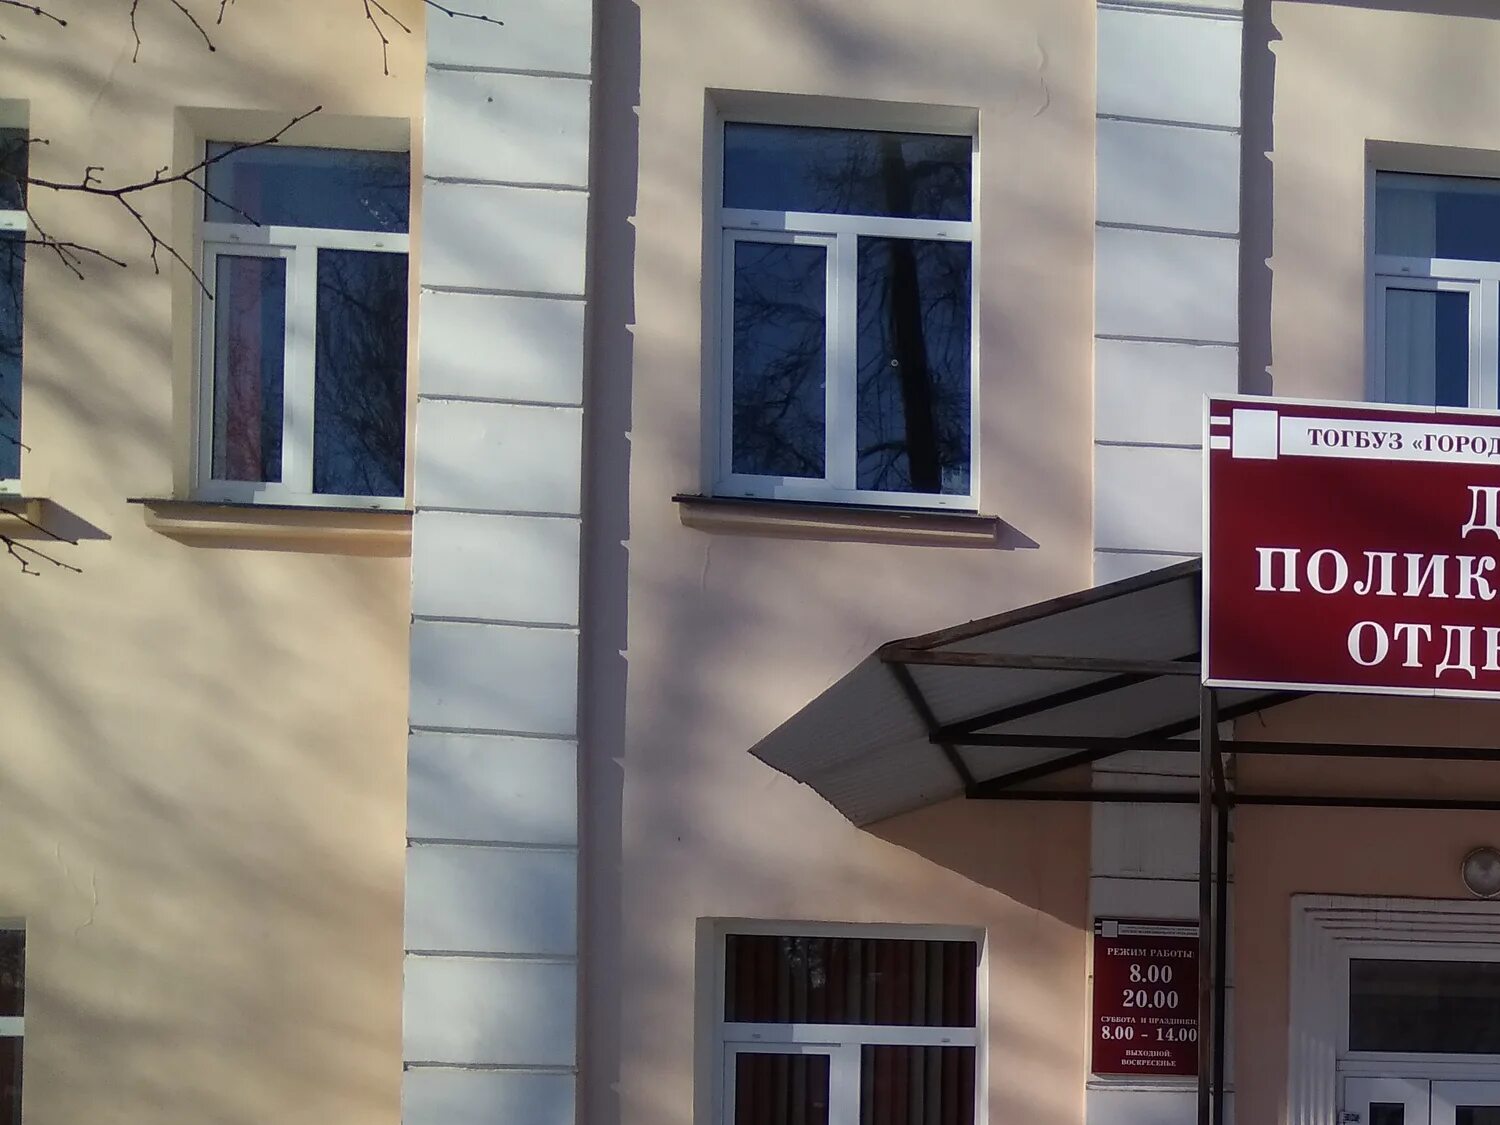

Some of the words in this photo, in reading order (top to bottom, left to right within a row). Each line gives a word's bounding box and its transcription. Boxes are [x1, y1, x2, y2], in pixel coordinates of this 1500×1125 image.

[1307, 428, 1403, 450] ТОГБУЗ
[1107, 947, 1147, 957] РЕЖИМ
[1129, 963, 1173, 983] 8.00
[1122, 989, 1179, 1008] 20.00
[1100, 1016, 1136, 1024] СУББОТА
[1101, 1025, 1134, 1040] 8.00
[1156, 1027, 1198, 1042] 14.00
[1121, 1058, 1177, 1067] ВОСКРЕСЕНЬЕ
